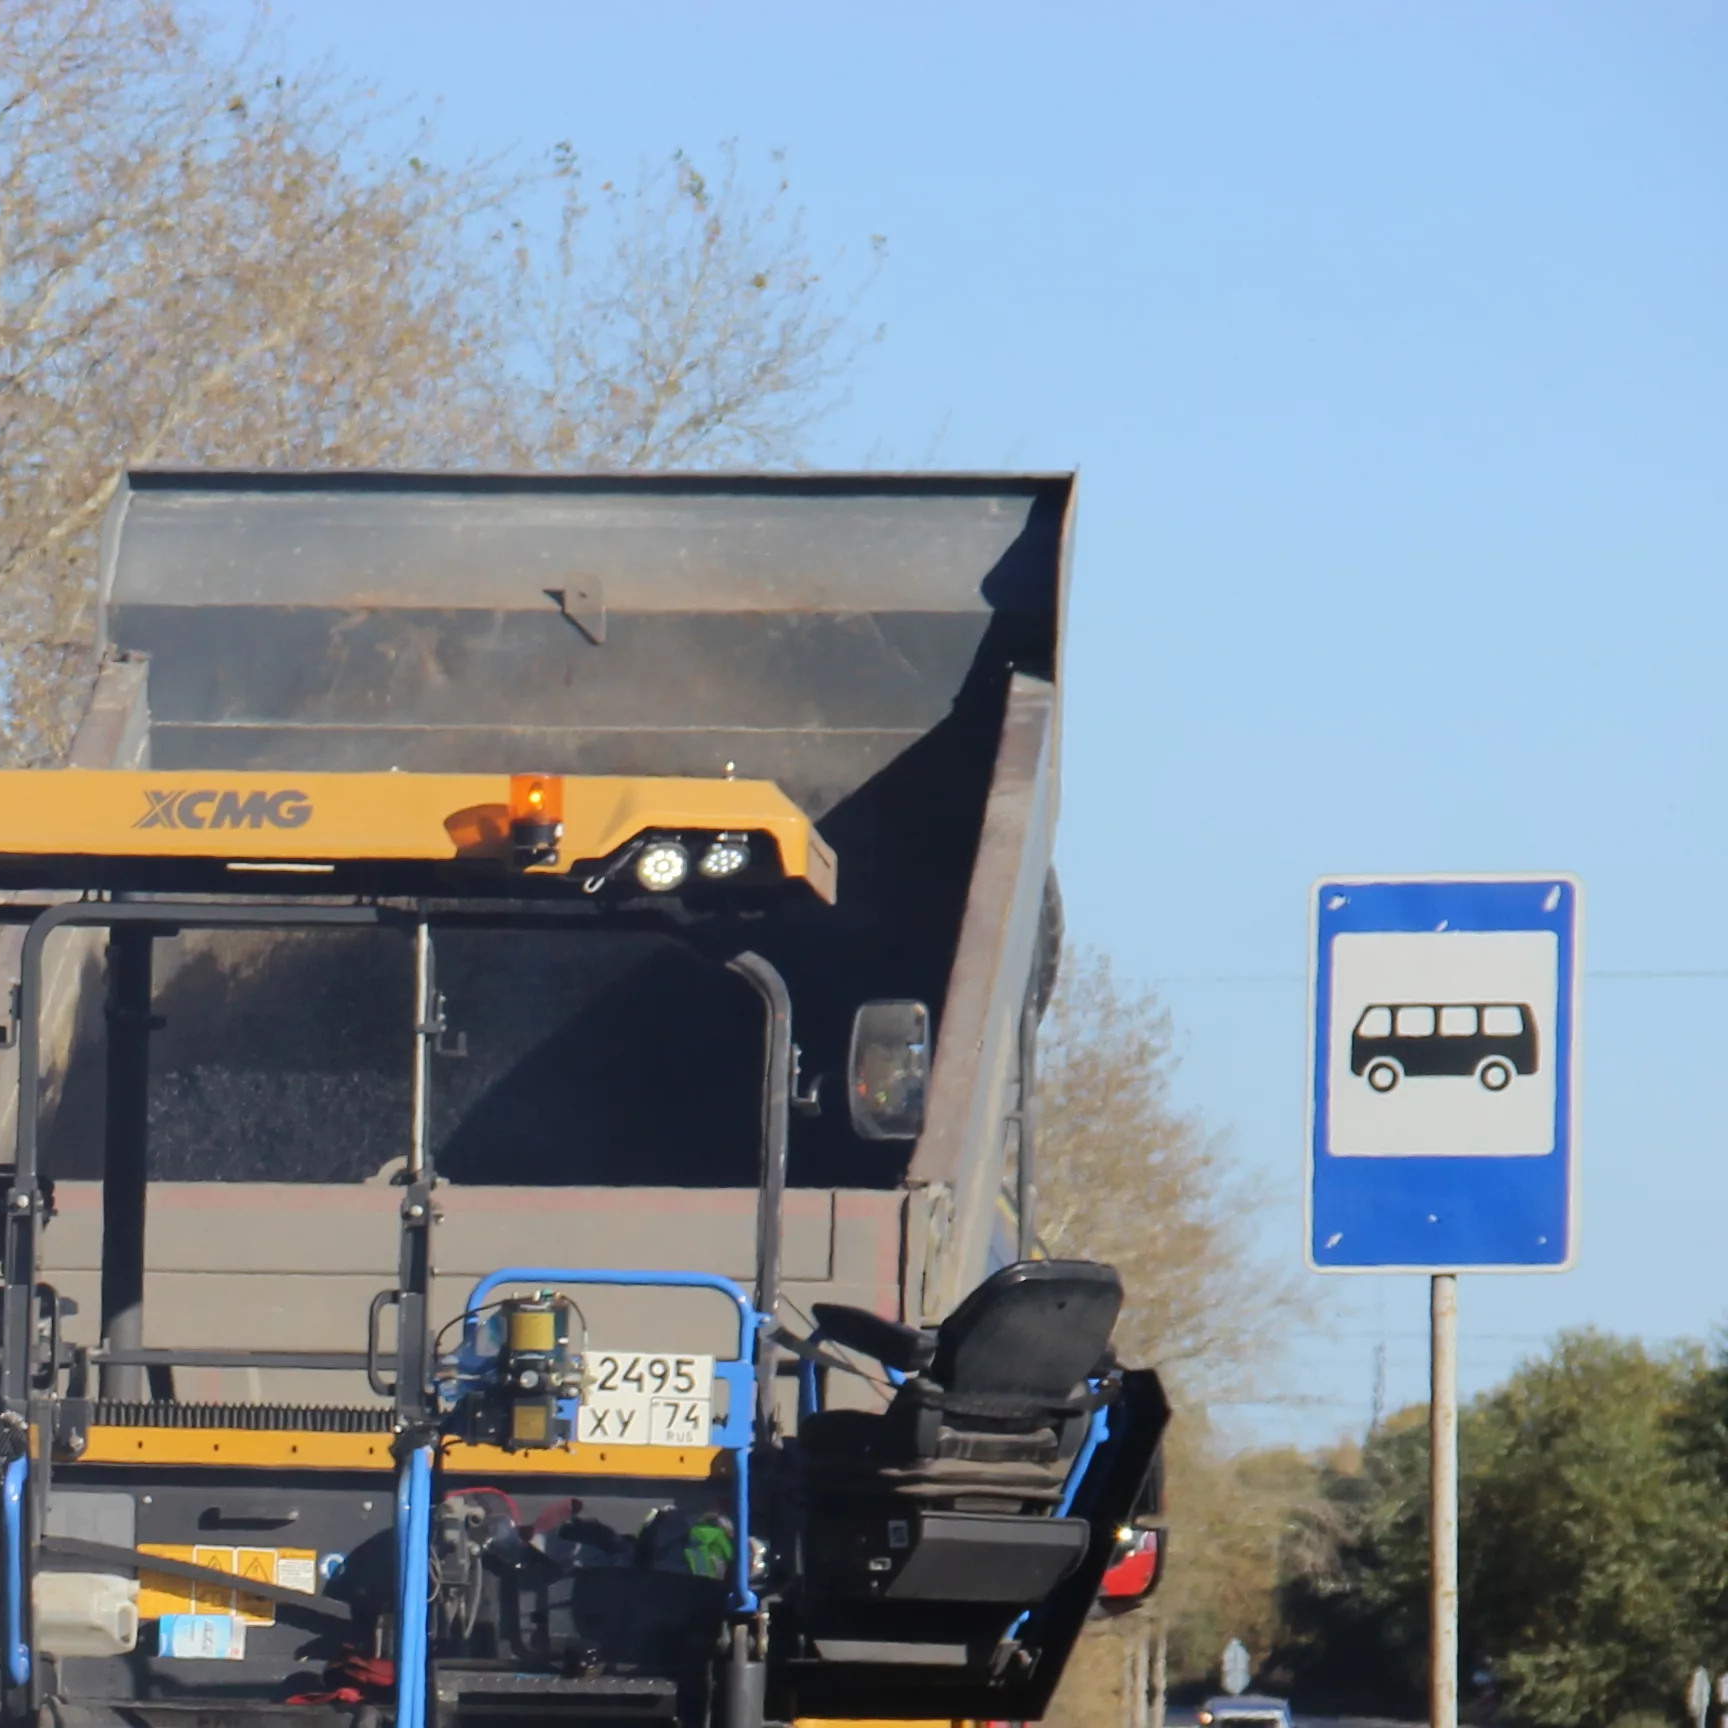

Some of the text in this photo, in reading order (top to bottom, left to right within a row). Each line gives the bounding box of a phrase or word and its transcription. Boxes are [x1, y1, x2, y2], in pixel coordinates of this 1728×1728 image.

[130, 789, 314, 829] XCMG
[597, 1356, 696, 1393] 2495
[663, 1402, 700, 1430] 74
